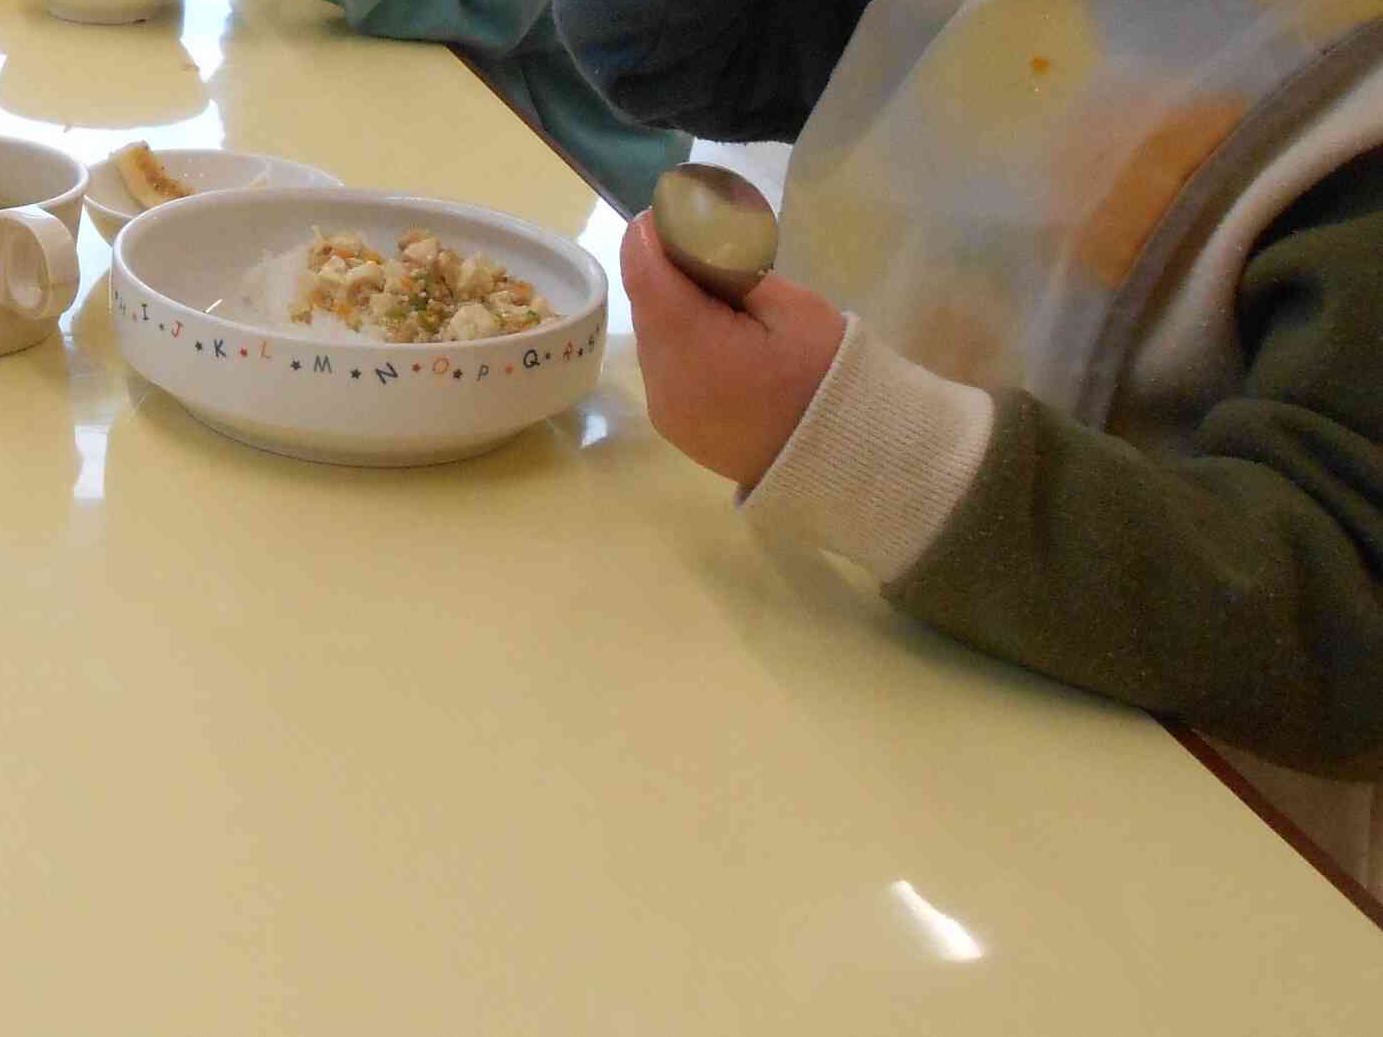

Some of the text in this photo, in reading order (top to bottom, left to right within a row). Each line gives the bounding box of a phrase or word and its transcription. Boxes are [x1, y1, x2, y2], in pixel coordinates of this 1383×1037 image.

[170, 320, 185, 339] J
[213, 338, 228, 359] K
[259, 339, 273, 359] L
[313, 354, 333, 375] M
[374, 362, 399, 386] N
[431, 356, 451, 375] O
[475, 364, 490, 382] P
[522, 348, 541, 369] Q
